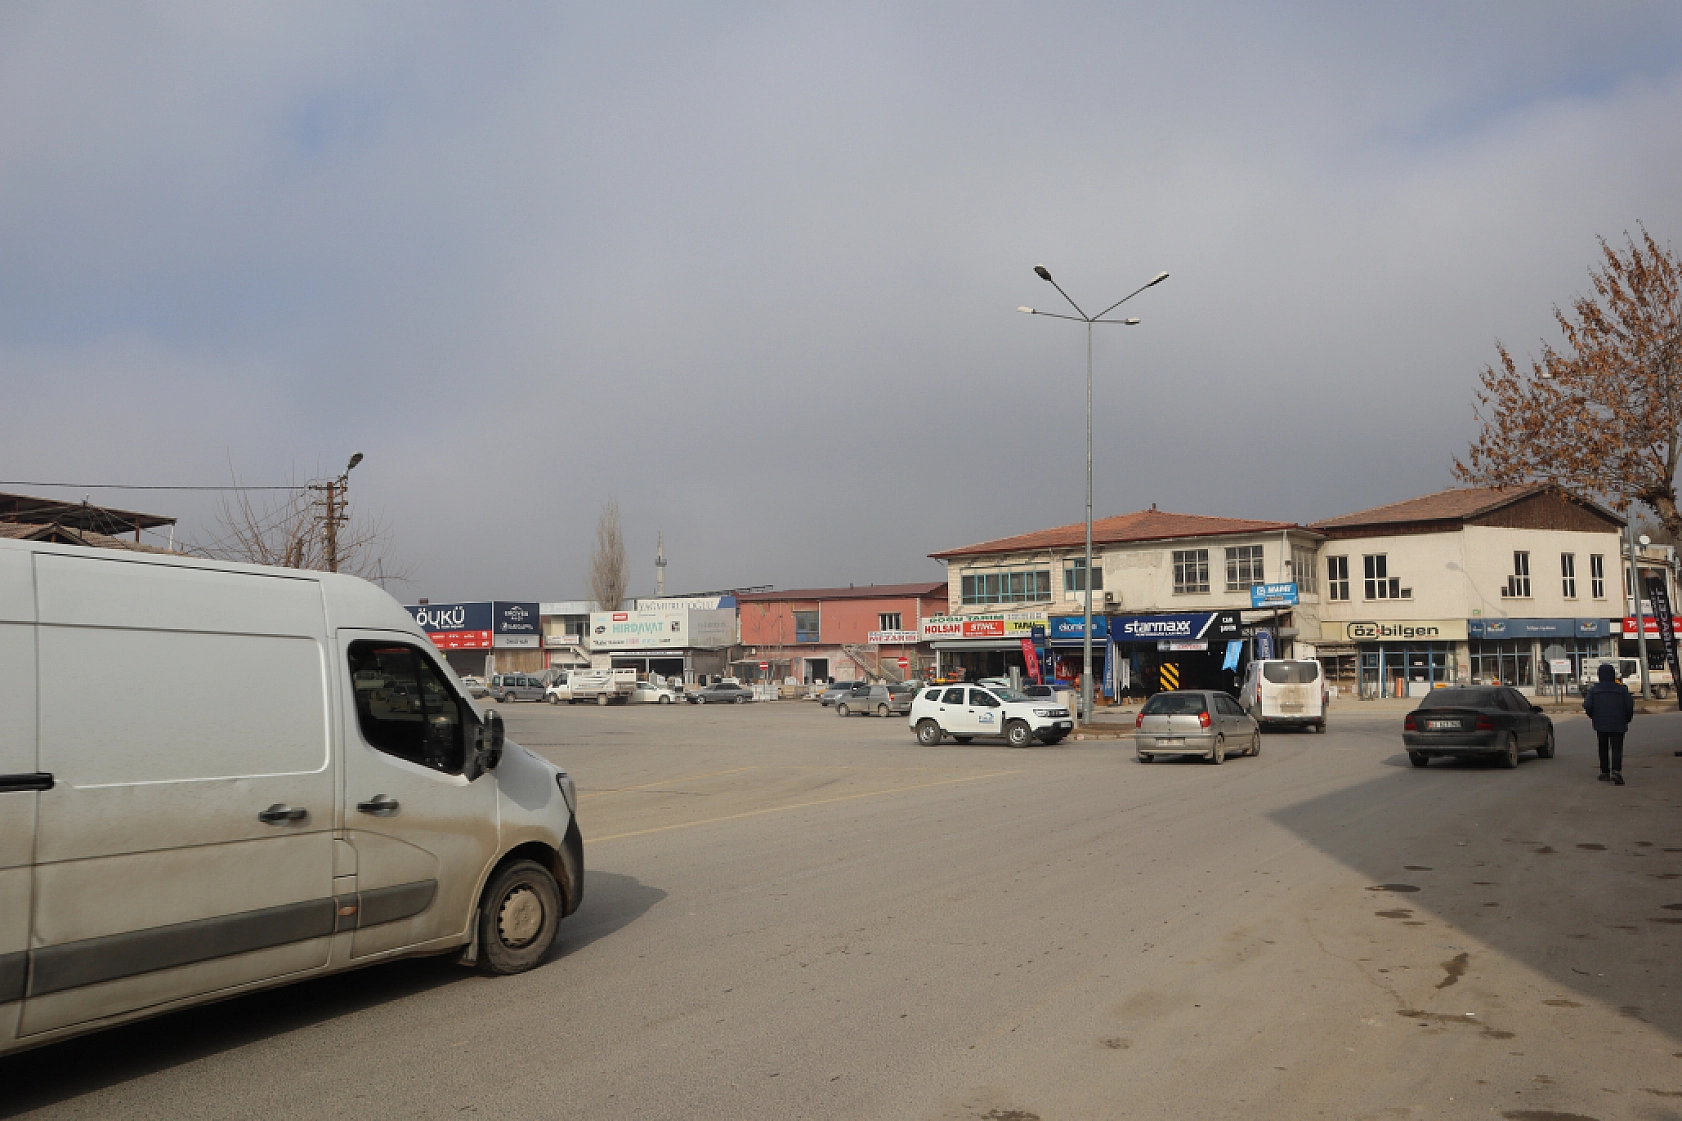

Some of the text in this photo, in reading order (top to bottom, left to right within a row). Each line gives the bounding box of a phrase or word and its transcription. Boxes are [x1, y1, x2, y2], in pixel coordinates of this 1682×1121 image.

[612, 621, 664, 634] HIRDAVAT
[1124, 620, 1191, 633] starmaxx
[1382, 624, 1439, 638] bilgen
